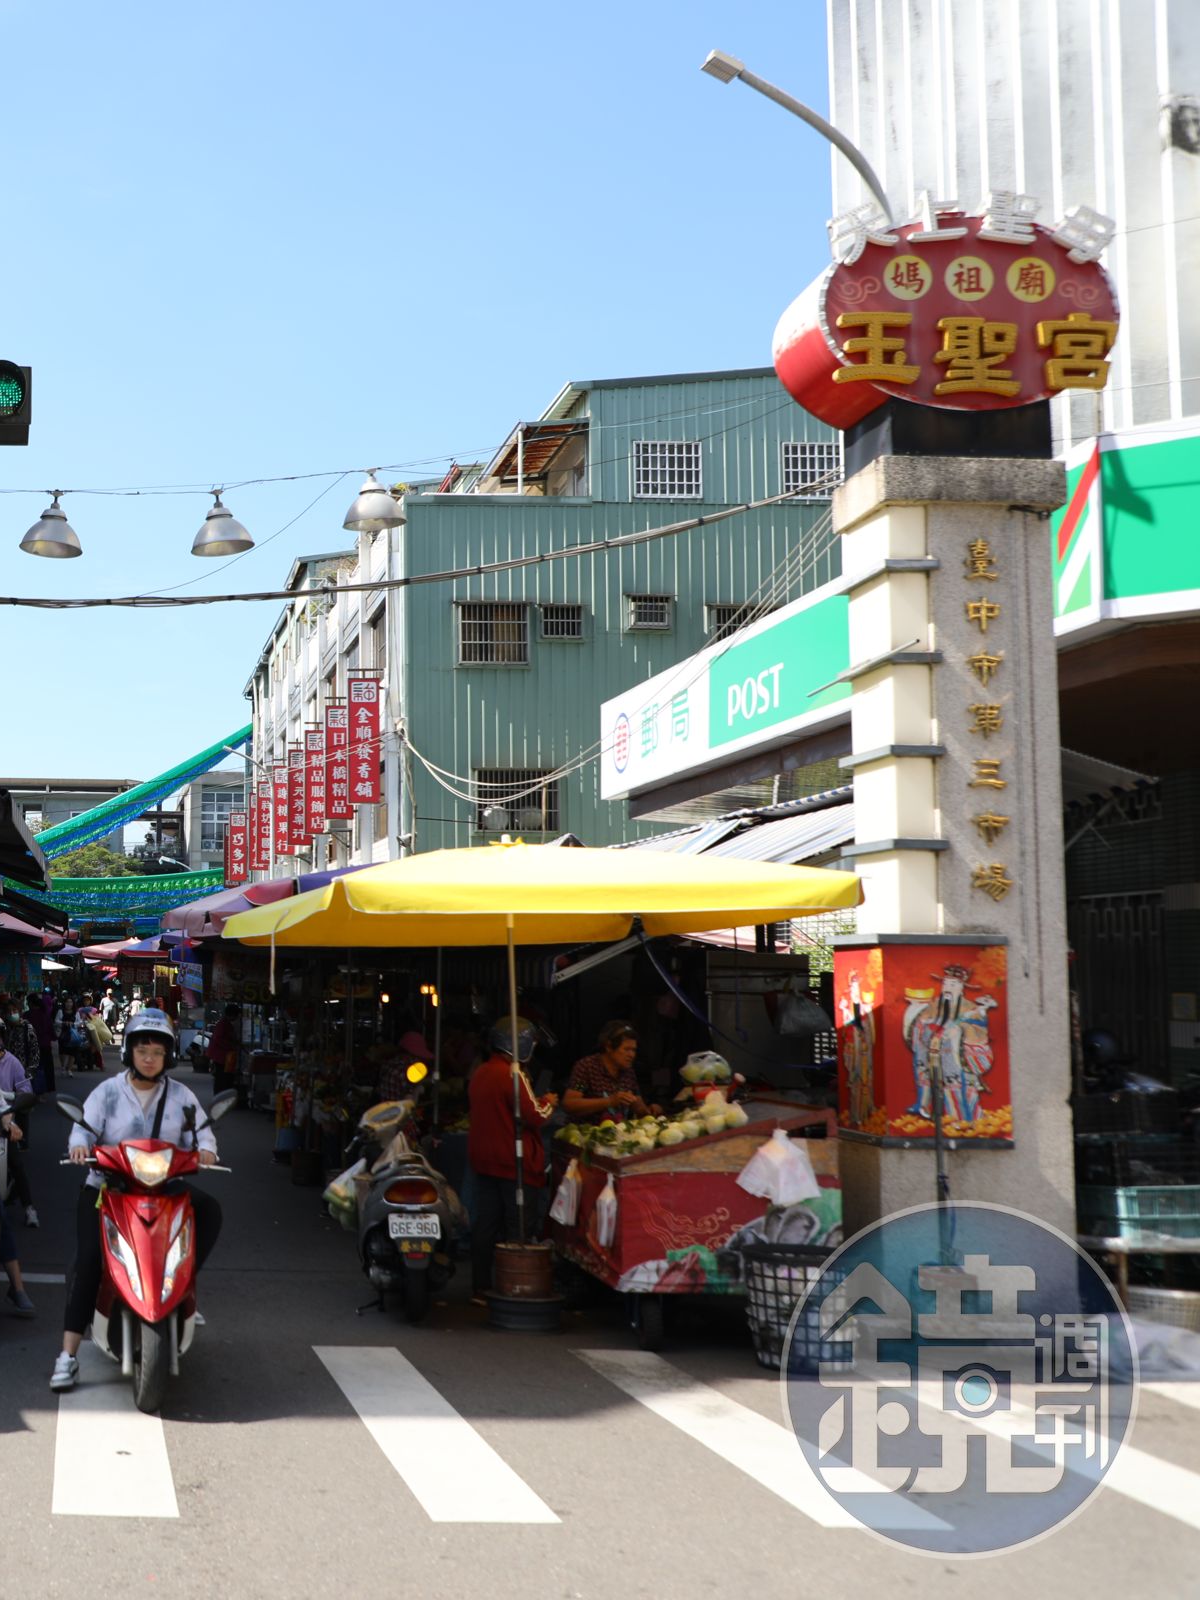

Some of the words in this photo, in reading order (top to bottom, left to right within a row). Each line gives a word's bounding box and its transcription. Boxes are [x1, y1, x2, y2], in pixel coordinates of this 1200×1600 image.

[826, 189, 1116, 266] 天上聖母
[891, 261, 1045, 297] 媽祖廟
[832, 312, 1118, 398] 玉聖宮
[640, 688, 690, 758] 郵局
[727, 661, 785, 727] POST
[964, 538, 1013, 902] 臺中市第三市場
[391, 1221, 439, 1235] G6E-960
